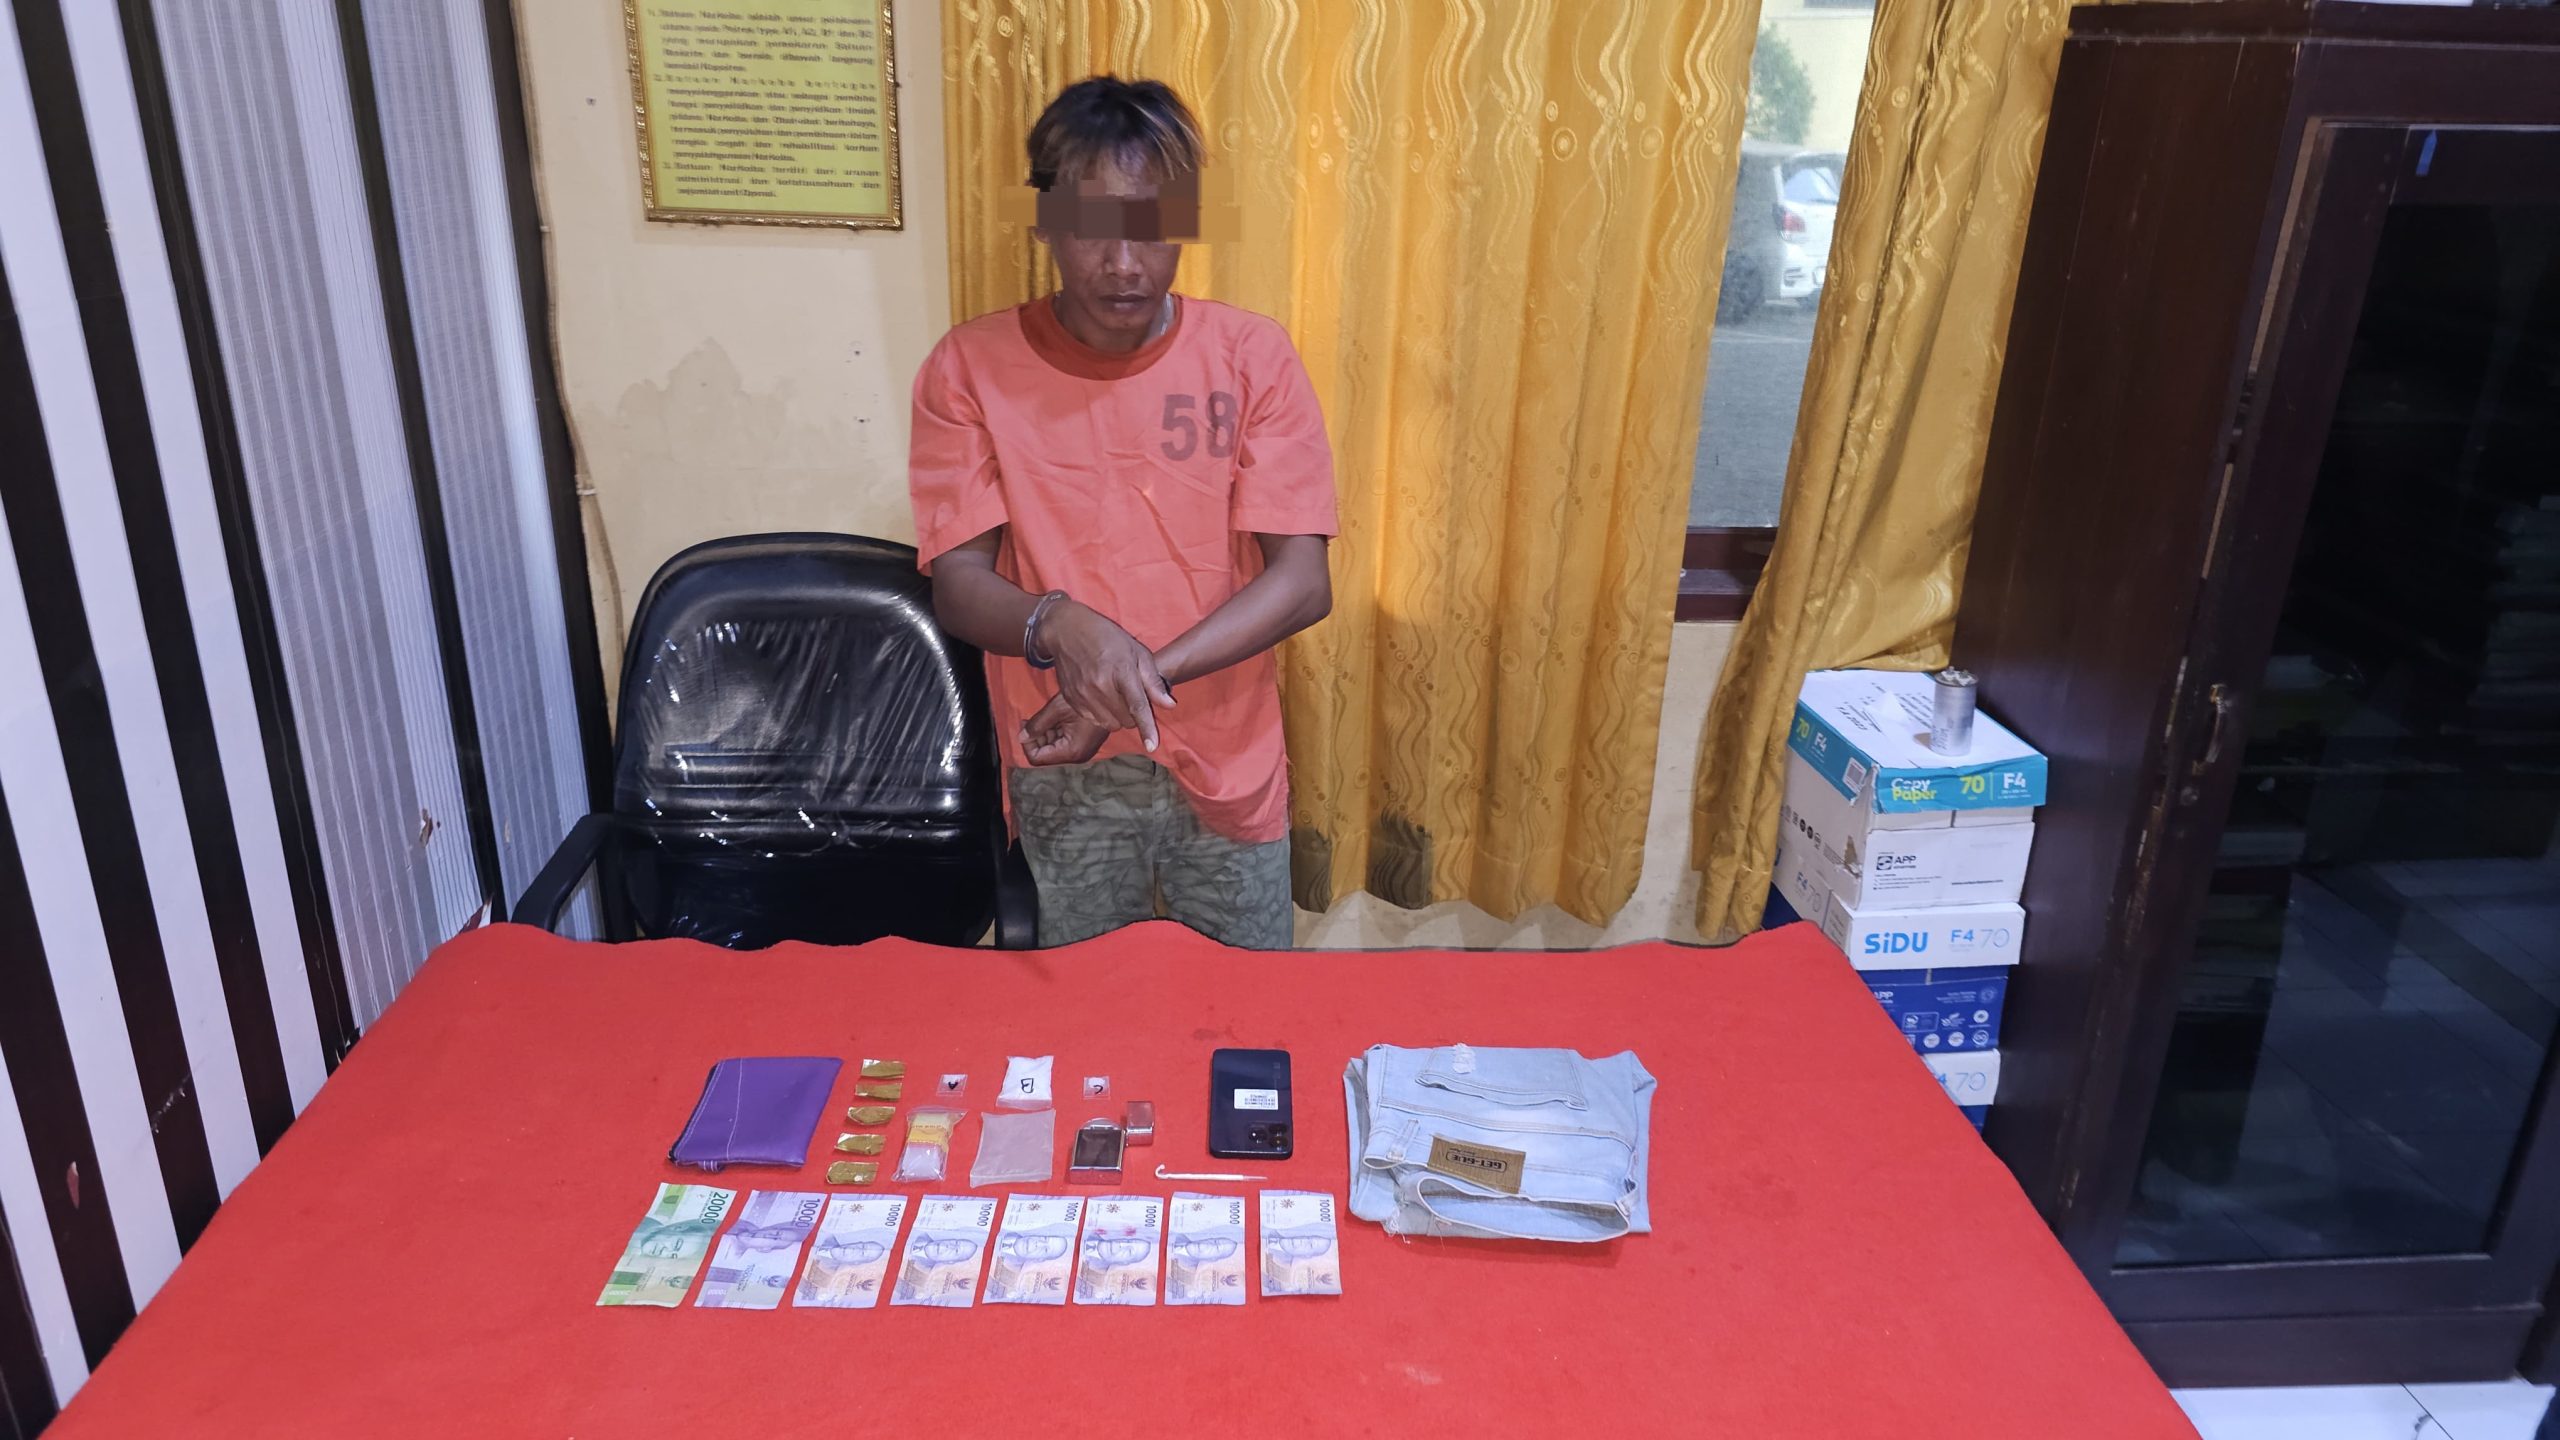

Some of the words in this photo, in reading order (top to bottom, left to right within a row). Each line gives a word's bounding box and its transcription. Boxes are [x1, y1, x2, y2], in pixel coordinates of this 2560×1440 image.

[1161, 391, 1237, 461] 58
[1795, 718, 1809, 738] 70
[1814, 733, 1827, 752] F4
[1891, 777, 1931, 791] Copy
[1960, 775, 1985, 794] 70
[2003, 772, 2026, 789] F4
[1892, 788, 1937, 804] Paper
[1894, 855, 1916, 864] APP
[1951, 929, 1974, 943] F4
[1980, 928, 2010, 948] 70
[1021, 1078, 1034, 1093] B
[1955, 1072, 1985, 1091] 70
[701, 1192, 729, 1224] 20000
[795, 1198, 820, 1228] 10000
[885, 1203, 901, 1227] 10000
[977, 1203, 993, 1226] 10000
[1144, 1205, 1157, 1227] 10000
[1229, 1201, 1240, 1225] 10000
[1320, 1199, 1331, 1222] 10000
